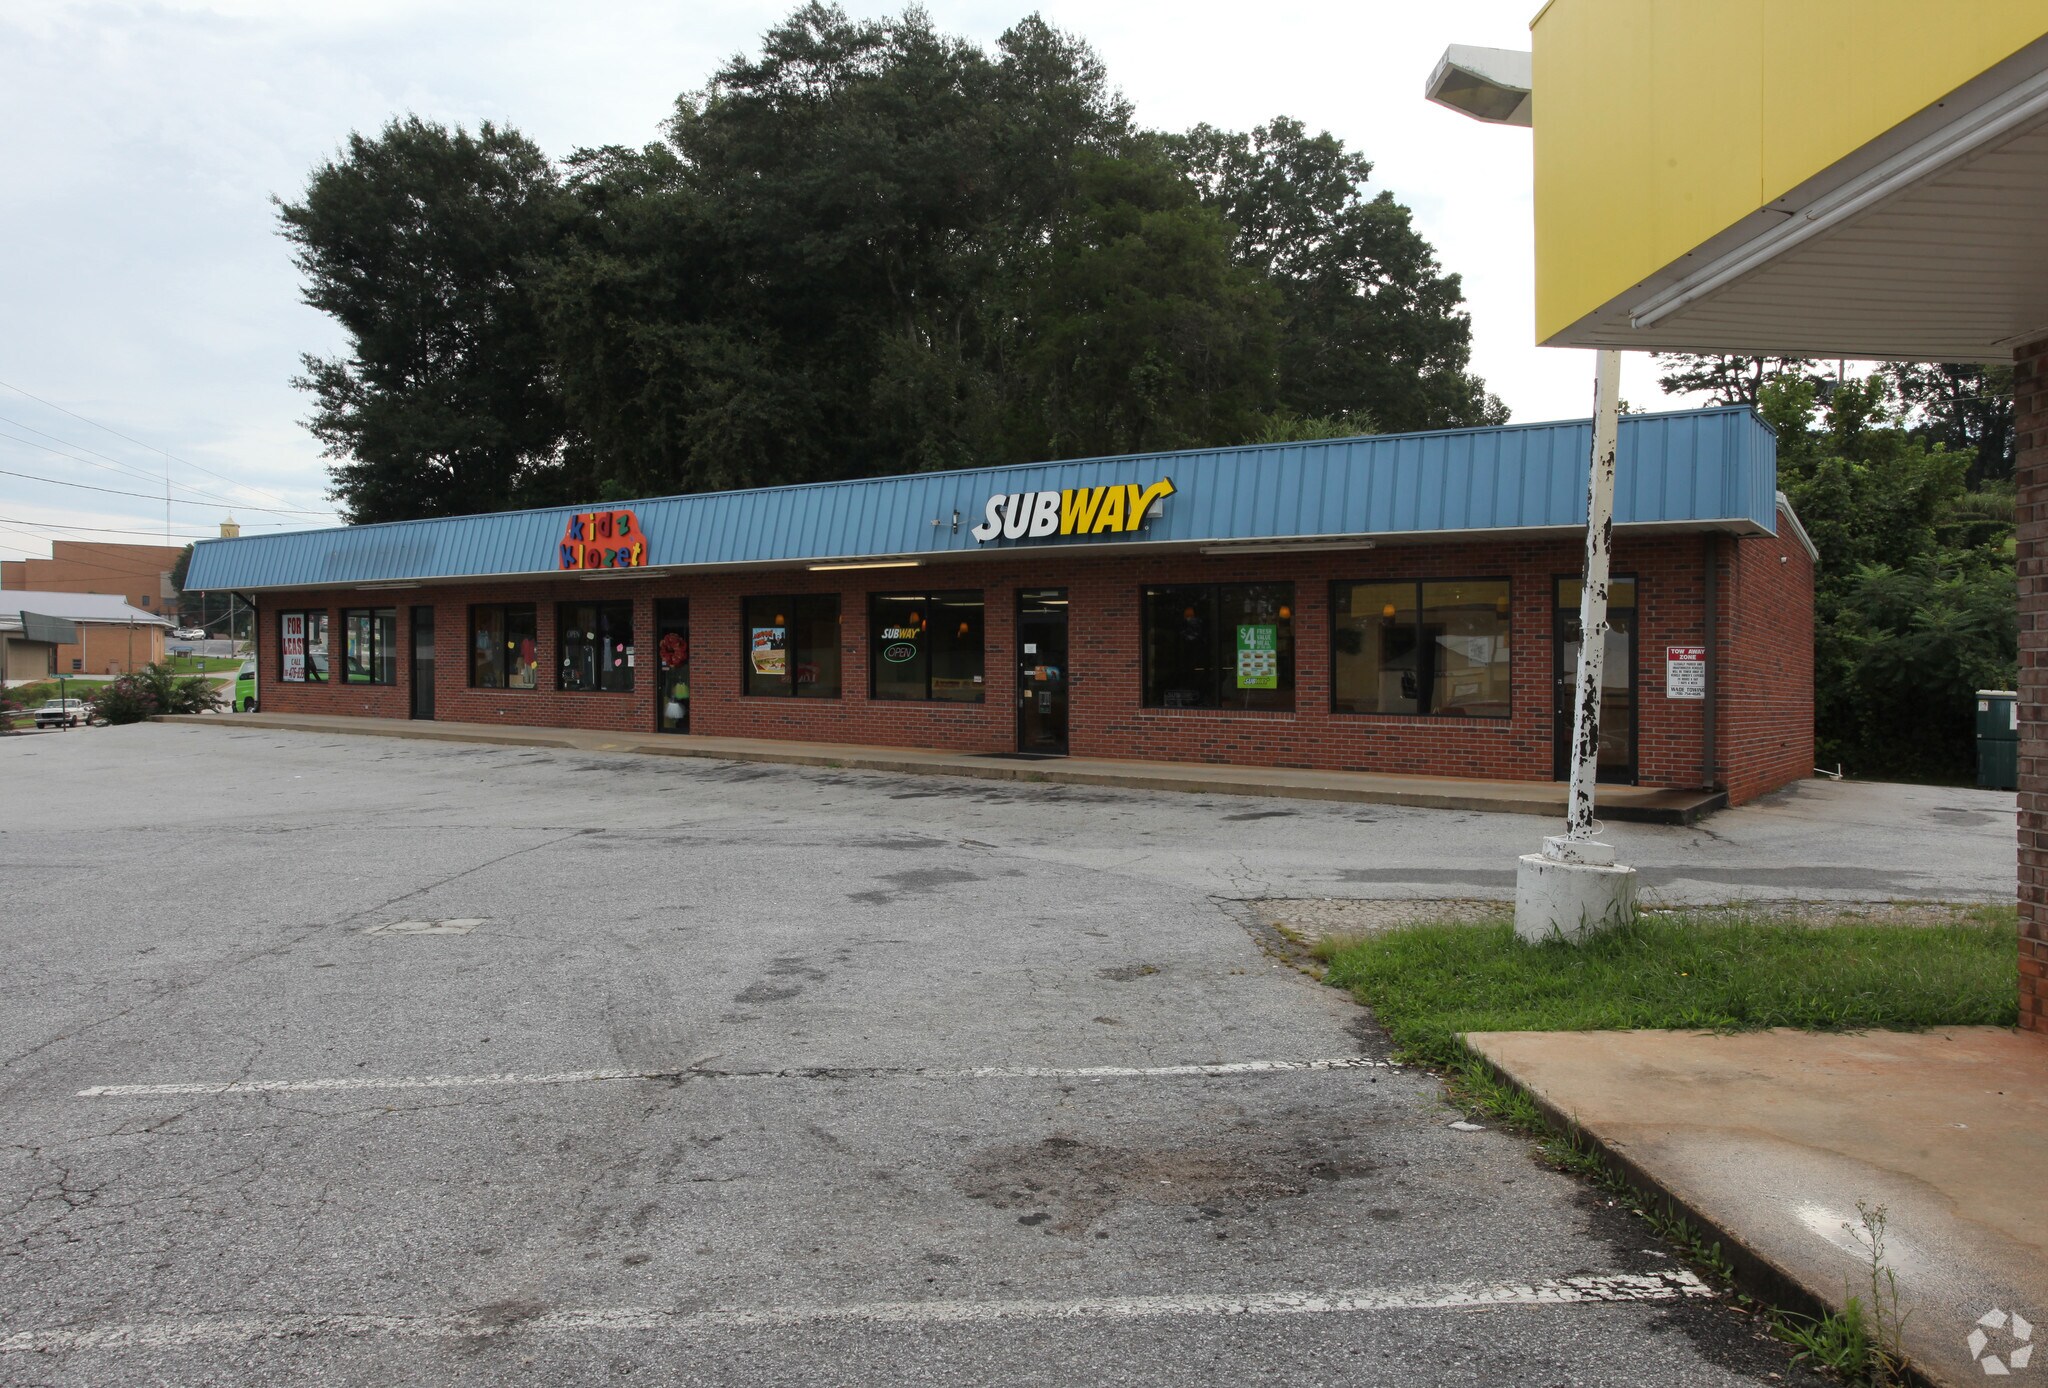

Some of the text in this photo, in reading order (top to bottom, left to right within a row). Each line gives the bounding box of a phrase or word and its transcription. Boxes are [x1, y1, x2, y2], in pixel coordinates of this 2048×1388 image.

[971, 477, 1177, 544] SUBWAY
[570, 511, 630, 541] kidz
[287, 617, 302, 635] FOR
[566, 630, 581, 638] OPEN
[881, 628, 920, 639] SUBWAY
[1240, 627, 1256, 649] $4
[888, 647, 912, 658] OPEN
[291, 658, 301, 666] CALL
